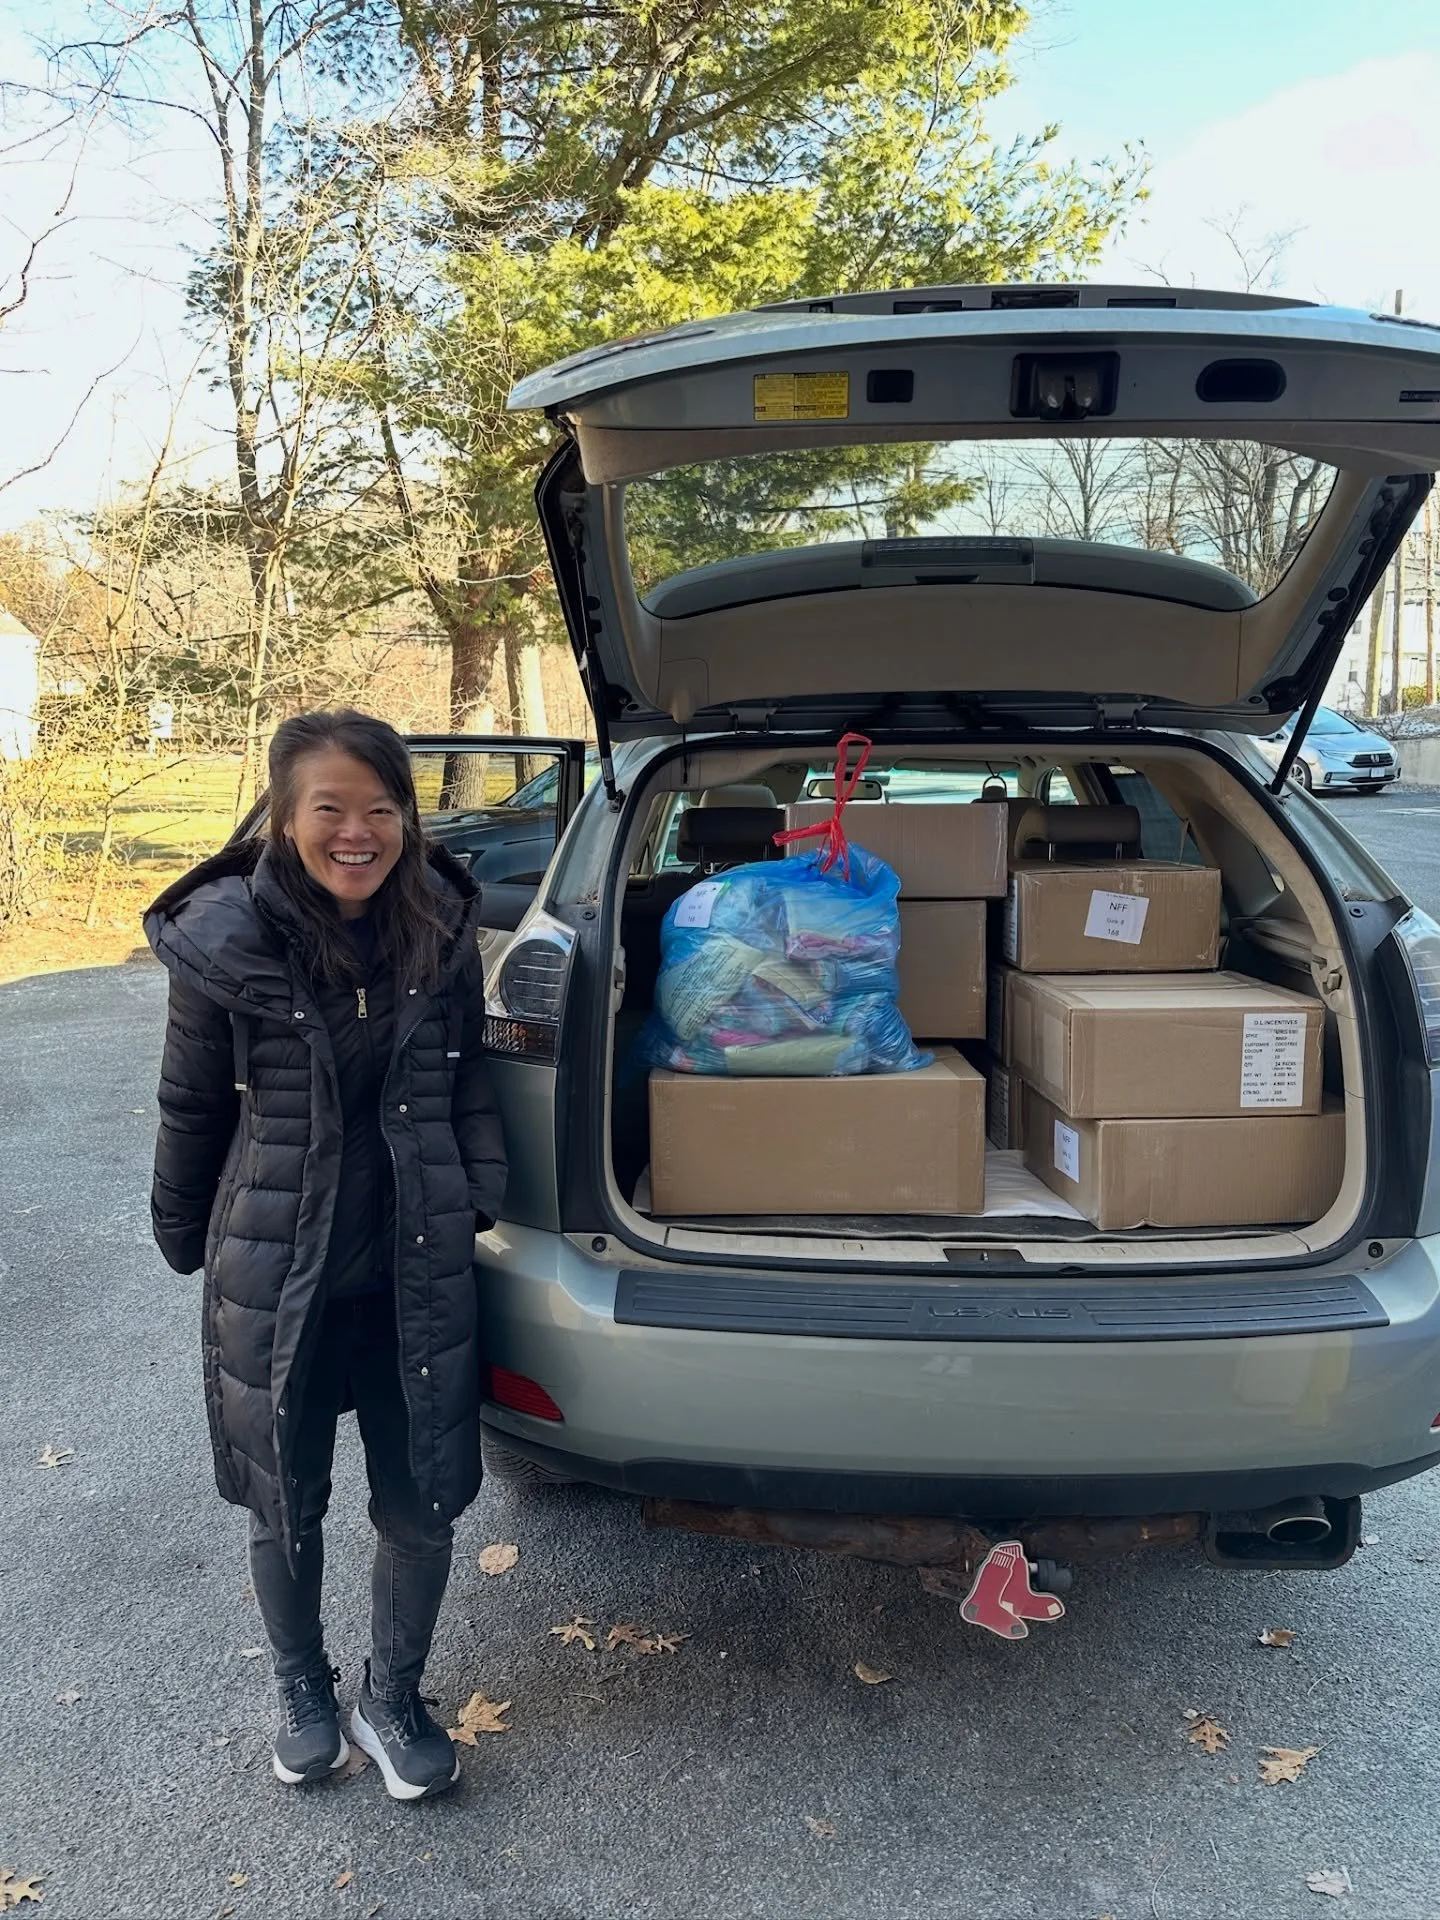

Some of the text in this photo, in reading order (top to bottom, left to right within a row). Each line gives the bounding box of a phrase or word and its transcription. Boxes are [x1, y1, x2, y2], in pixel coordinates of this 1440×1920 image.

[1109, 901, 1129, 912] NFF
[1108, 928, 1120, 936] 168
[928, 1306, 1072, 1319] LEXUS
